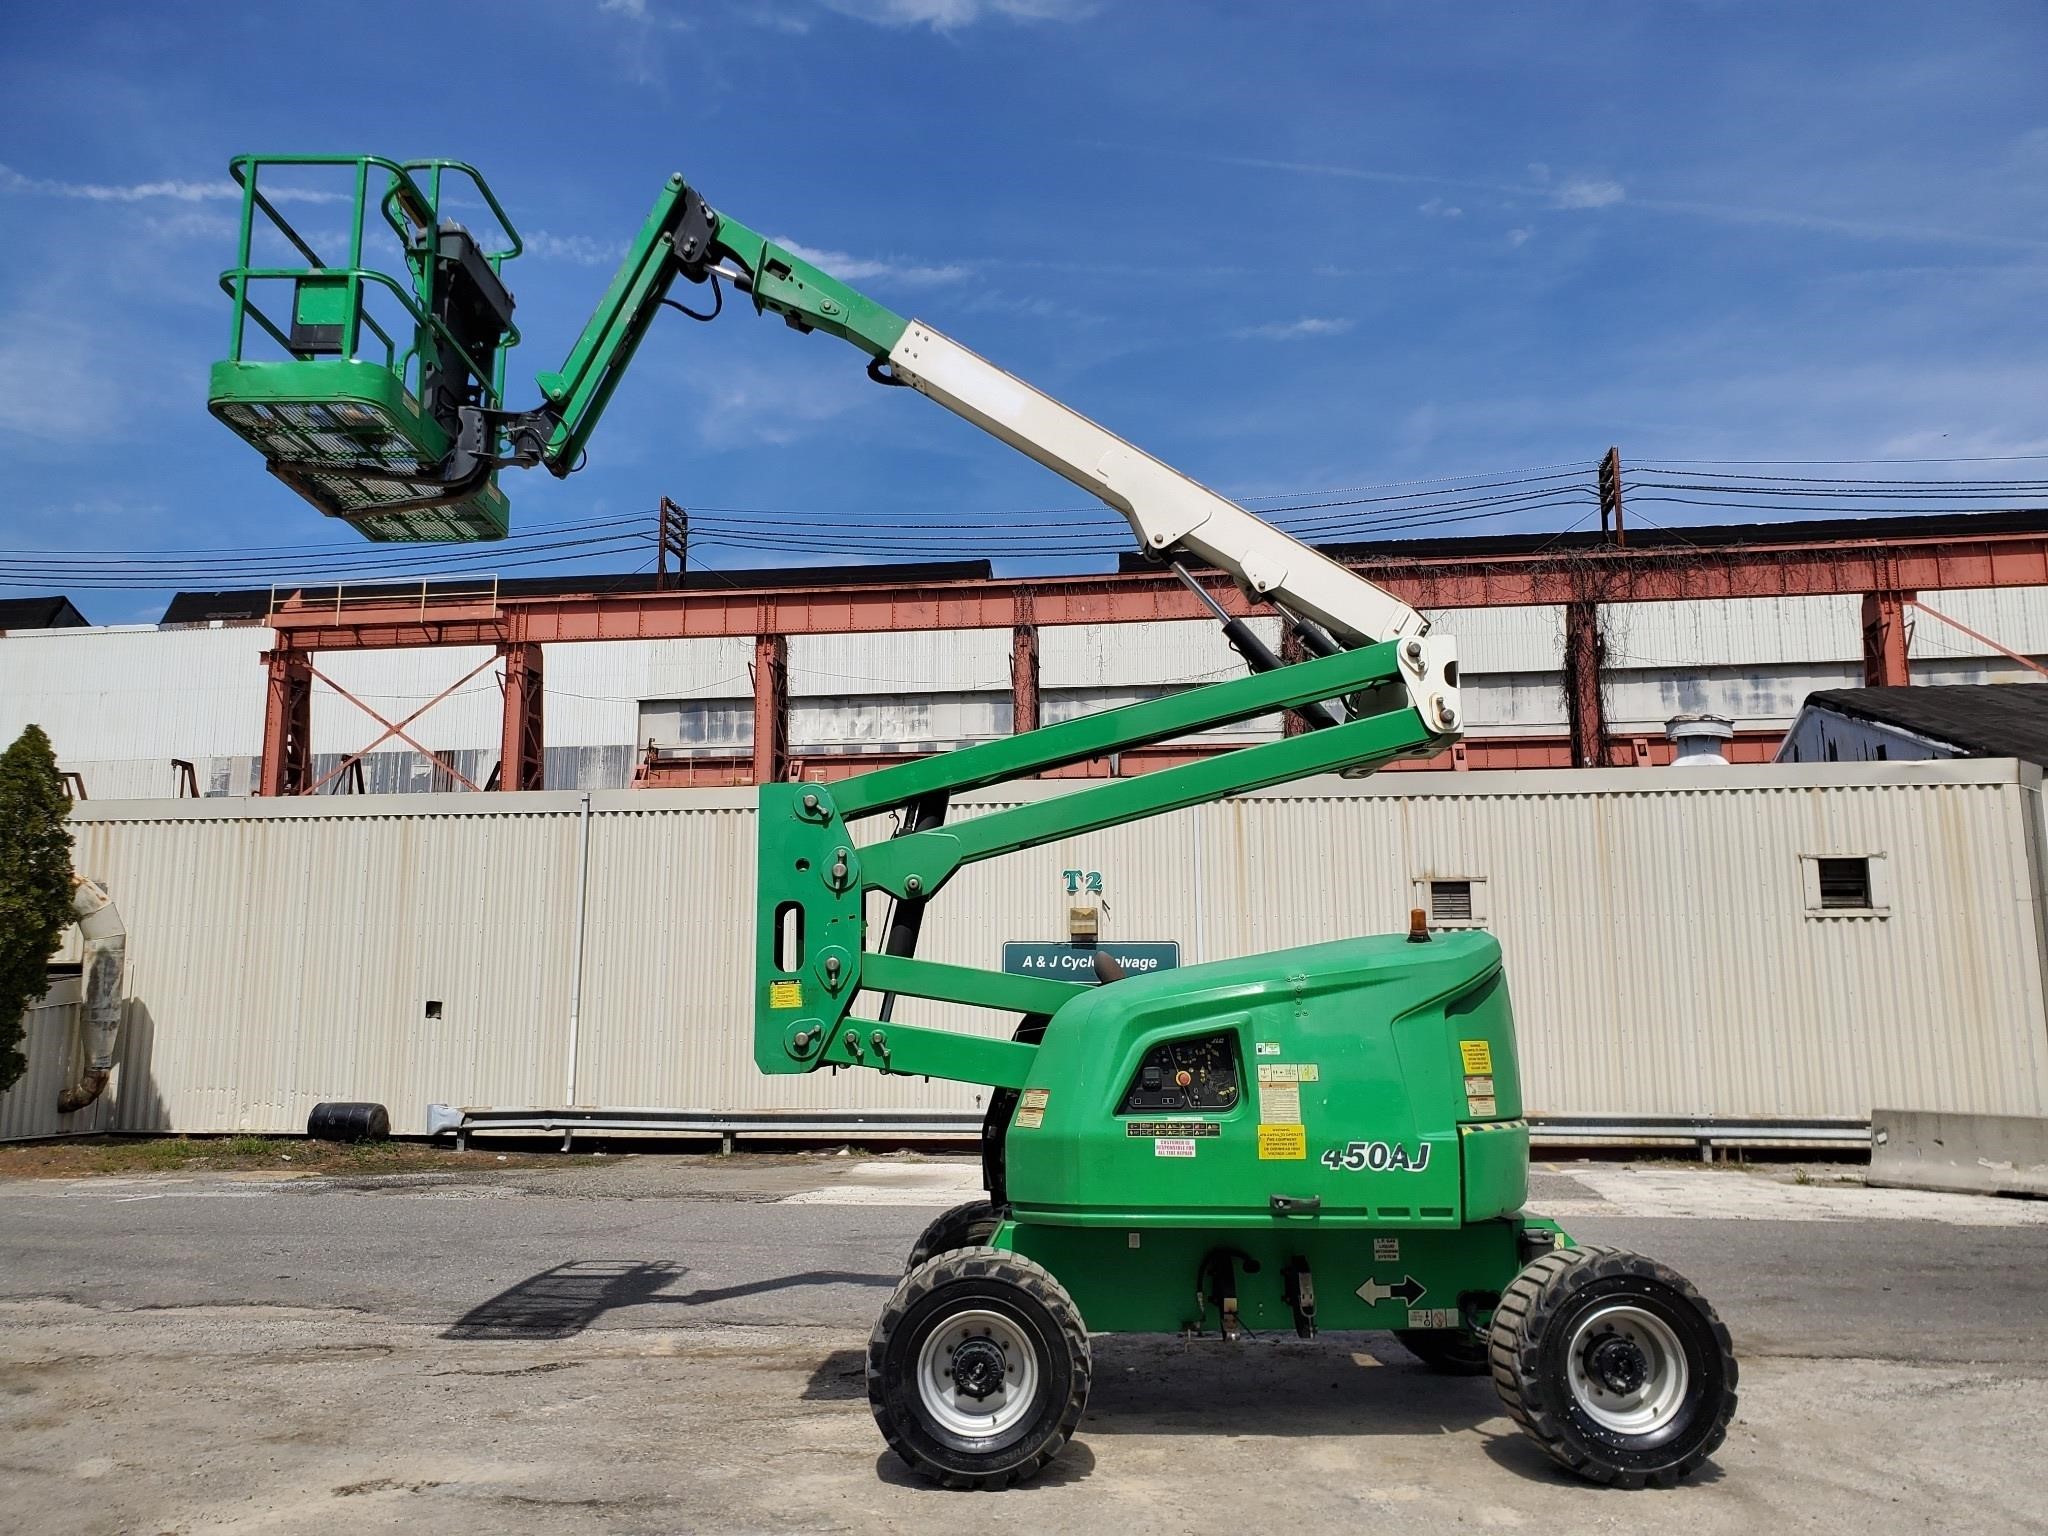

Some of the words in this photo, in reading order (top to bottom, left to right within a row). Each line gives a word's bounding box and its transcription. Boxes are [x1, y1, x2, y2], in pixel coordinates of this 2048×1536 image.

[1063, 870, 1103, 891] T2
[1022, 956, 1033, 968] A
[1036, 955, 1046, 968] &
[1049, 956, 1058, 968] J
[1061, 956, 1095, 971] Cycl
[1114, 956, 1158, 971] lvage
[1321, 1142, 1431, 1172] 450AJ
